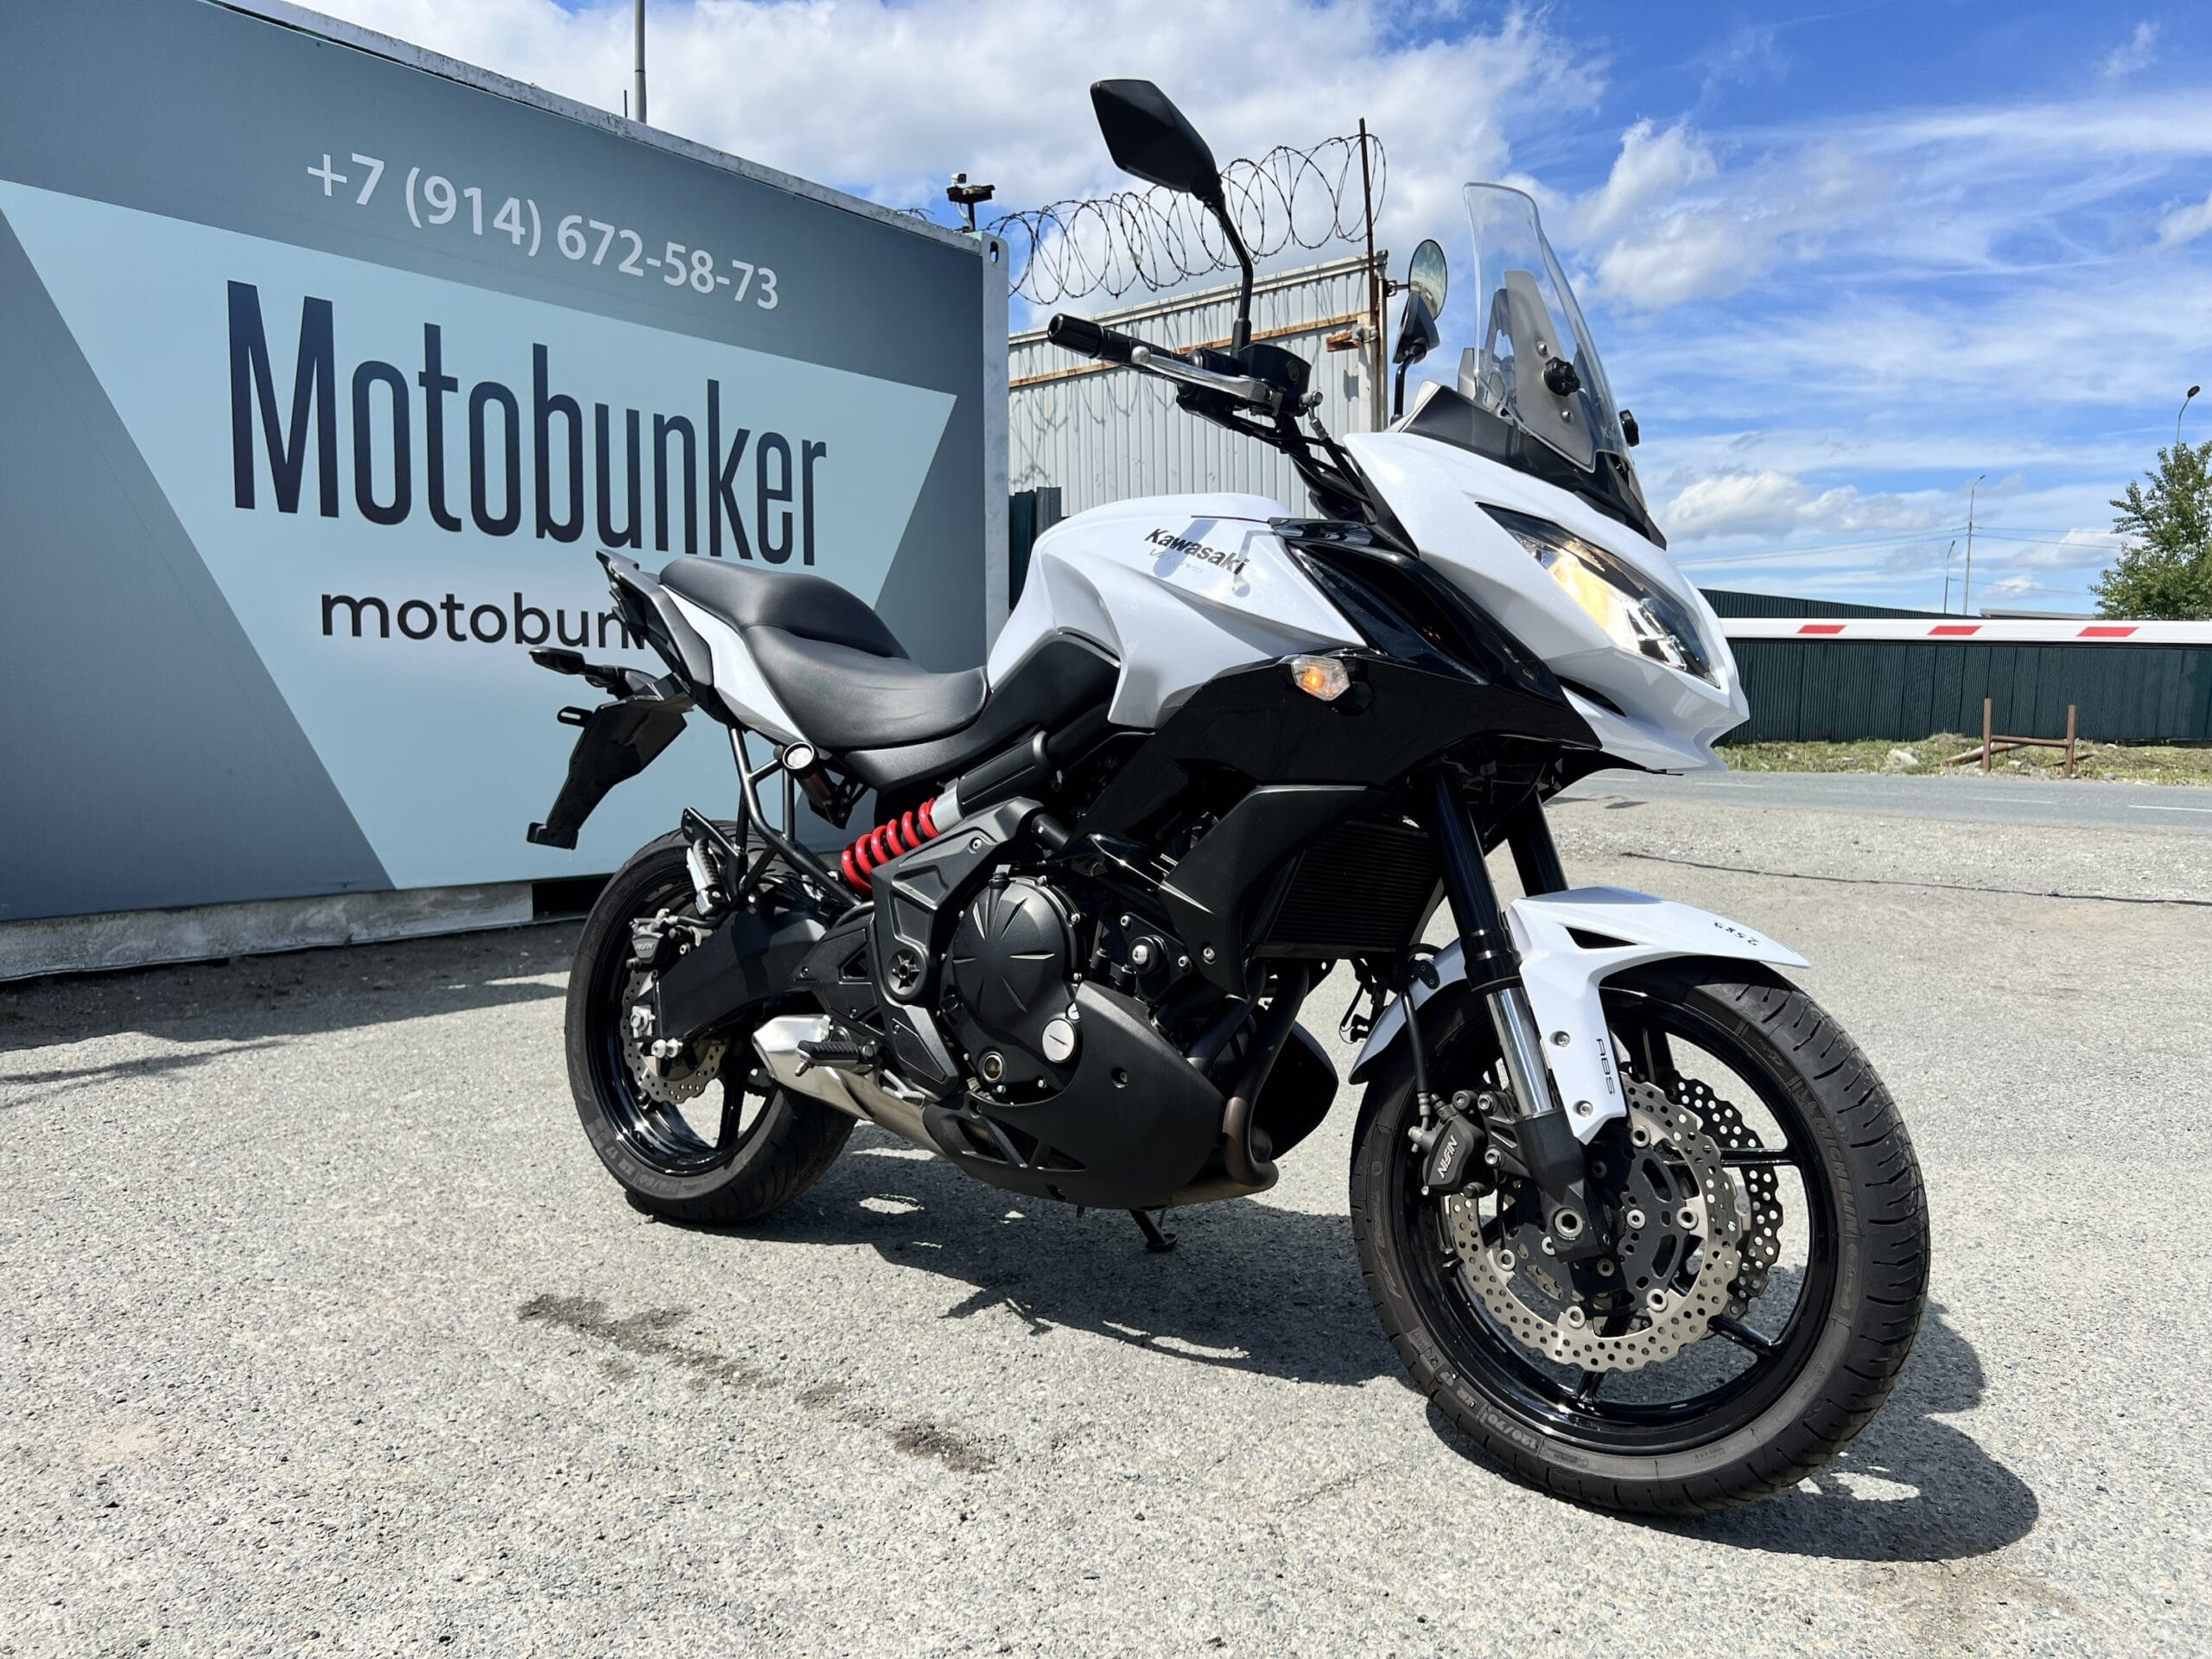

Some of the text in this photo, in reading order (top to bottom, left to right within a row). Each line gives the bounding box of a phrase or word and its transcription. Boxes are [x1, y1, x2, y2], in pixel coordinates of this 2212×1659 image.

[307, 152, 779, 309] +7 (914) 672-58-73
[226, 279, 827, 567] Motobunker
[1144, 528, 1250, 575] Kawasaki
[321, 592, 645, 650] motobun
[1596, 1039, 1616, 1095] ABS
